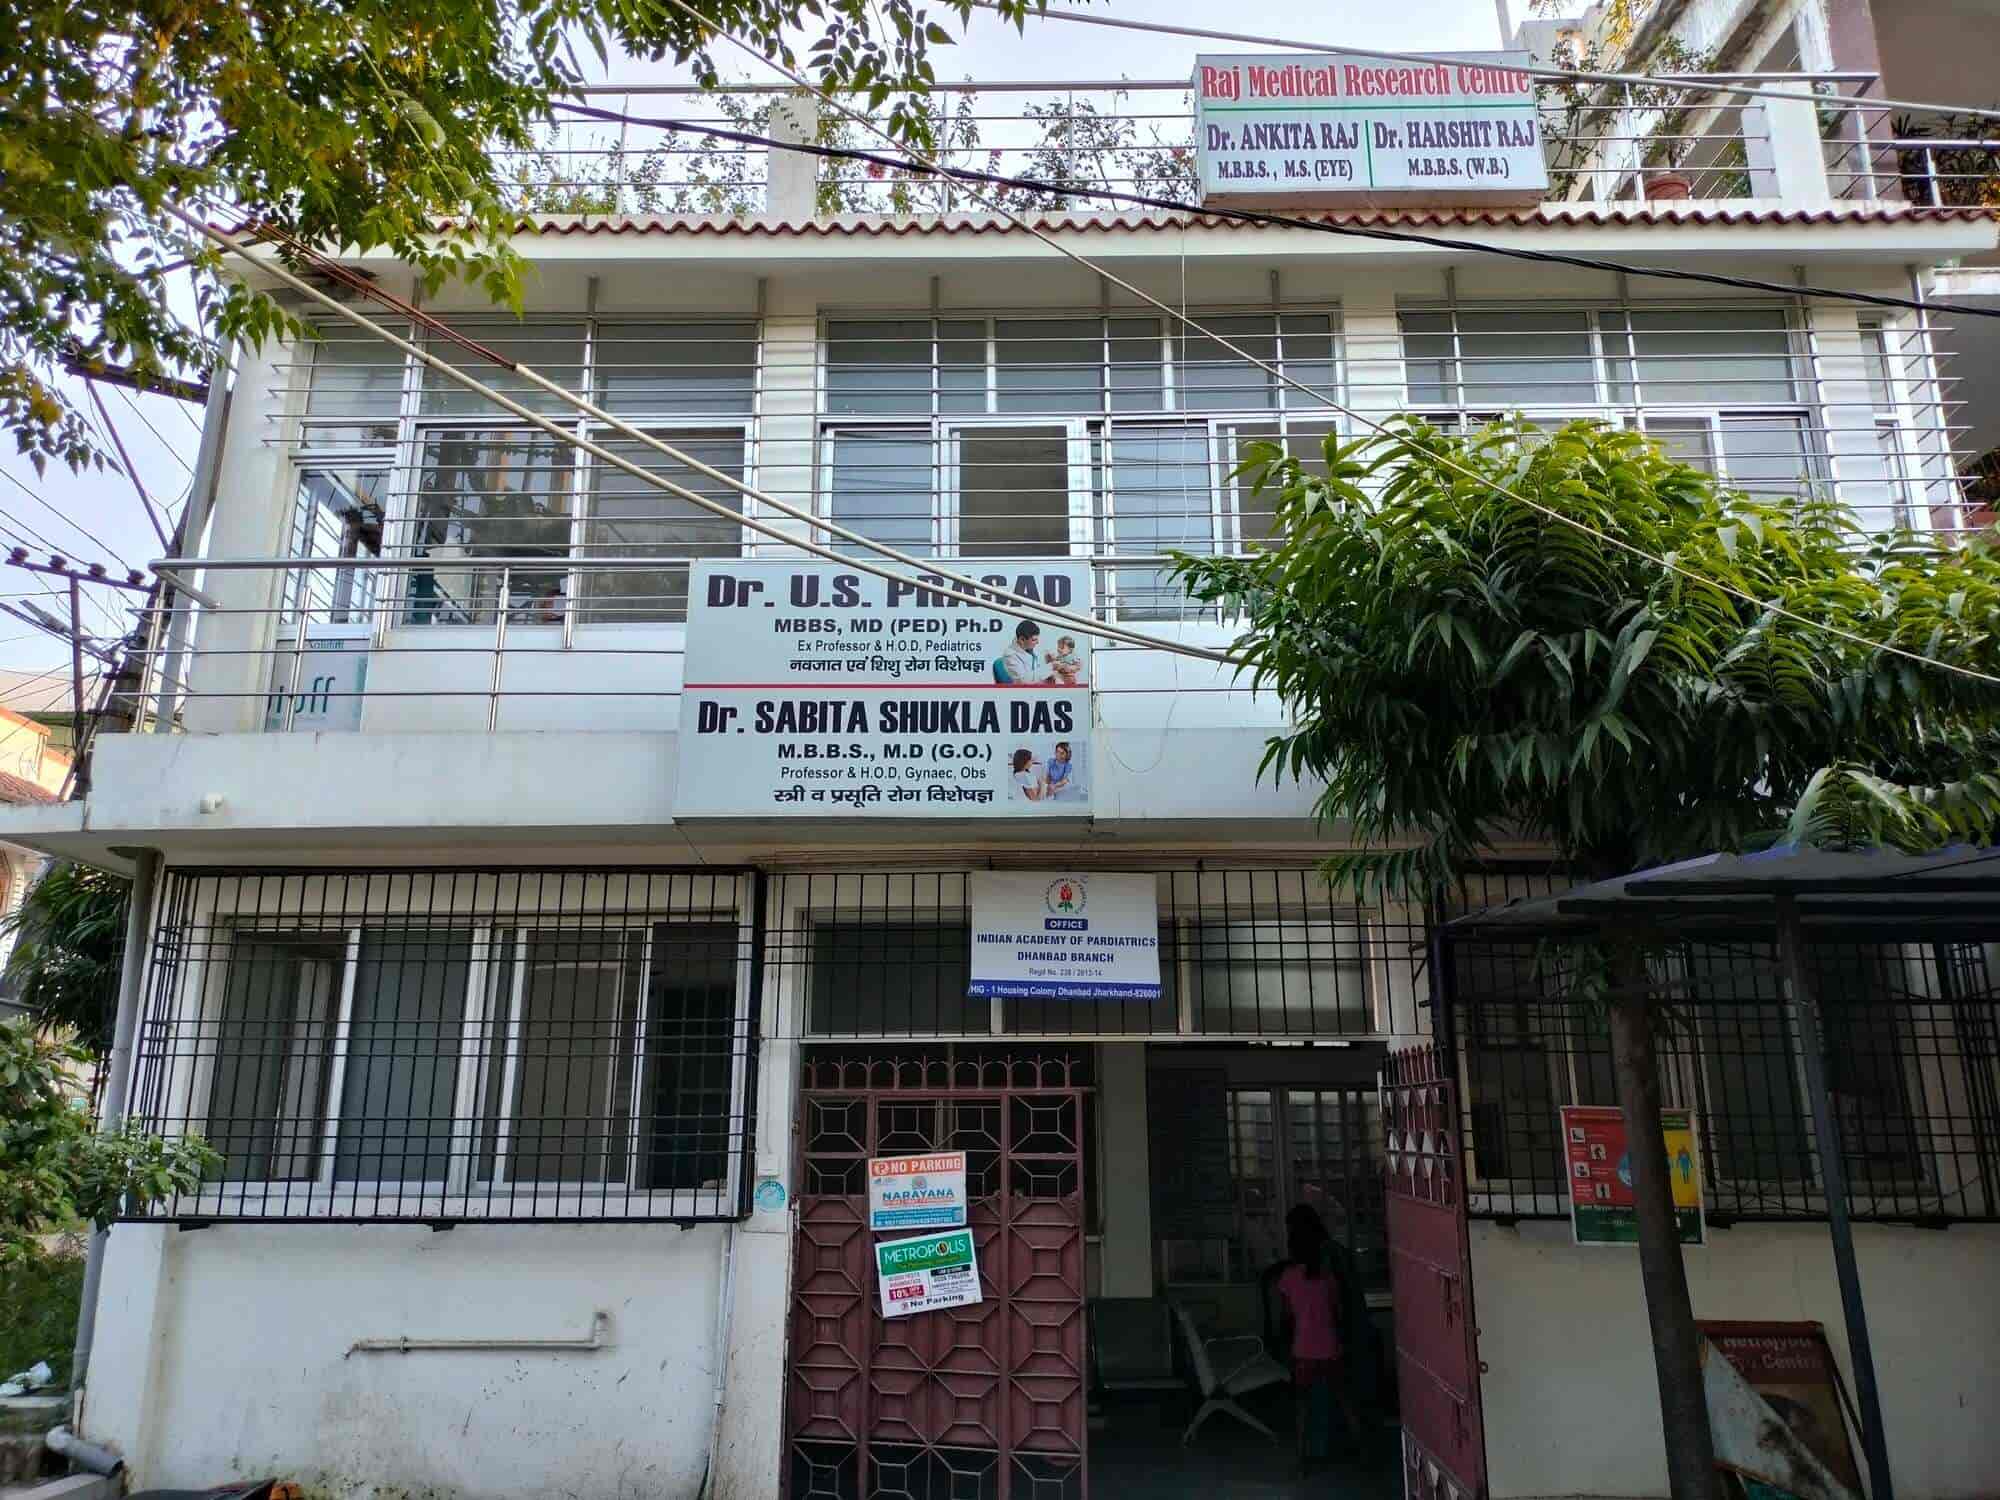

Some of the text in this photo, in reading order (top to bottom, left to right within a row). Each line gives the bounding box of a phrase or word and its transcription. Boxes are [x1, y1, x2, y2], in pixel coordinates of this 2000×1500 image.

[1201, 65, 1241, 102] Raj
[1248, 64, 1337, 97] Medical
[1344, 63, 1450, 97] Research
[1207, 121, 1359, 150] Dr. ANKITA RAJ
[1374, 119, 1535, 149] Dr. HARSHIT RAJ
[1284, 159, 1311, 178] M.S.
[1315, 159, 1353, 181] (EYE)
[1408, 157, 1510, 180] M.B.B.S. (W.B.)
[707, 574, 1072, 608] Dr. U.S. PRASAD
[774, 617, 1003, 638] MBBS, MD (PED) Ph.D
[798, 640, 812, 652] Ex
[815, 639, 872, 652] Professor
[875, 640, 883, 652] &
[925, 639, 982, 652] Pediatrics
[789, 655, 985, 677] नवजात एवं शिशु रोग विशेषज्ञ
[697, 700, 1073, 734] Dr. SABITA SHUKLA DAS
[777, 743, 993, 762] M.B.B.S., M.D (G.O.)
[781, 766, 844, 779] Professor
[847, 767, 857, 779] &
[905, 766, 958, 783] Gynaec,
[960, 766, 986, 779] Obs
[774, 784, 994, 807] स्त्री व प्रसूति रोग विशेषज्ञ
[1050, 919, 1083, 929] OFFICE
[977, 933, 1157, 948] INDIAN ACADEMY OF PARDIATRICS
[1018, 951, 1114, 963] DHANBAD BRANCH
[998, 985, 1029, 997] Housing
[1030, 986, 1056, 998] Colony
[1058, 986, 1092, 997] Dhanbad
[890, 1158, 961, 1173] NO PARKING
[882, 1188, 955, 1201] NARAYANA
[884, 1239, 966, 1265] METROPOLIS
[910, 1293, 965, 1308] No Parking
